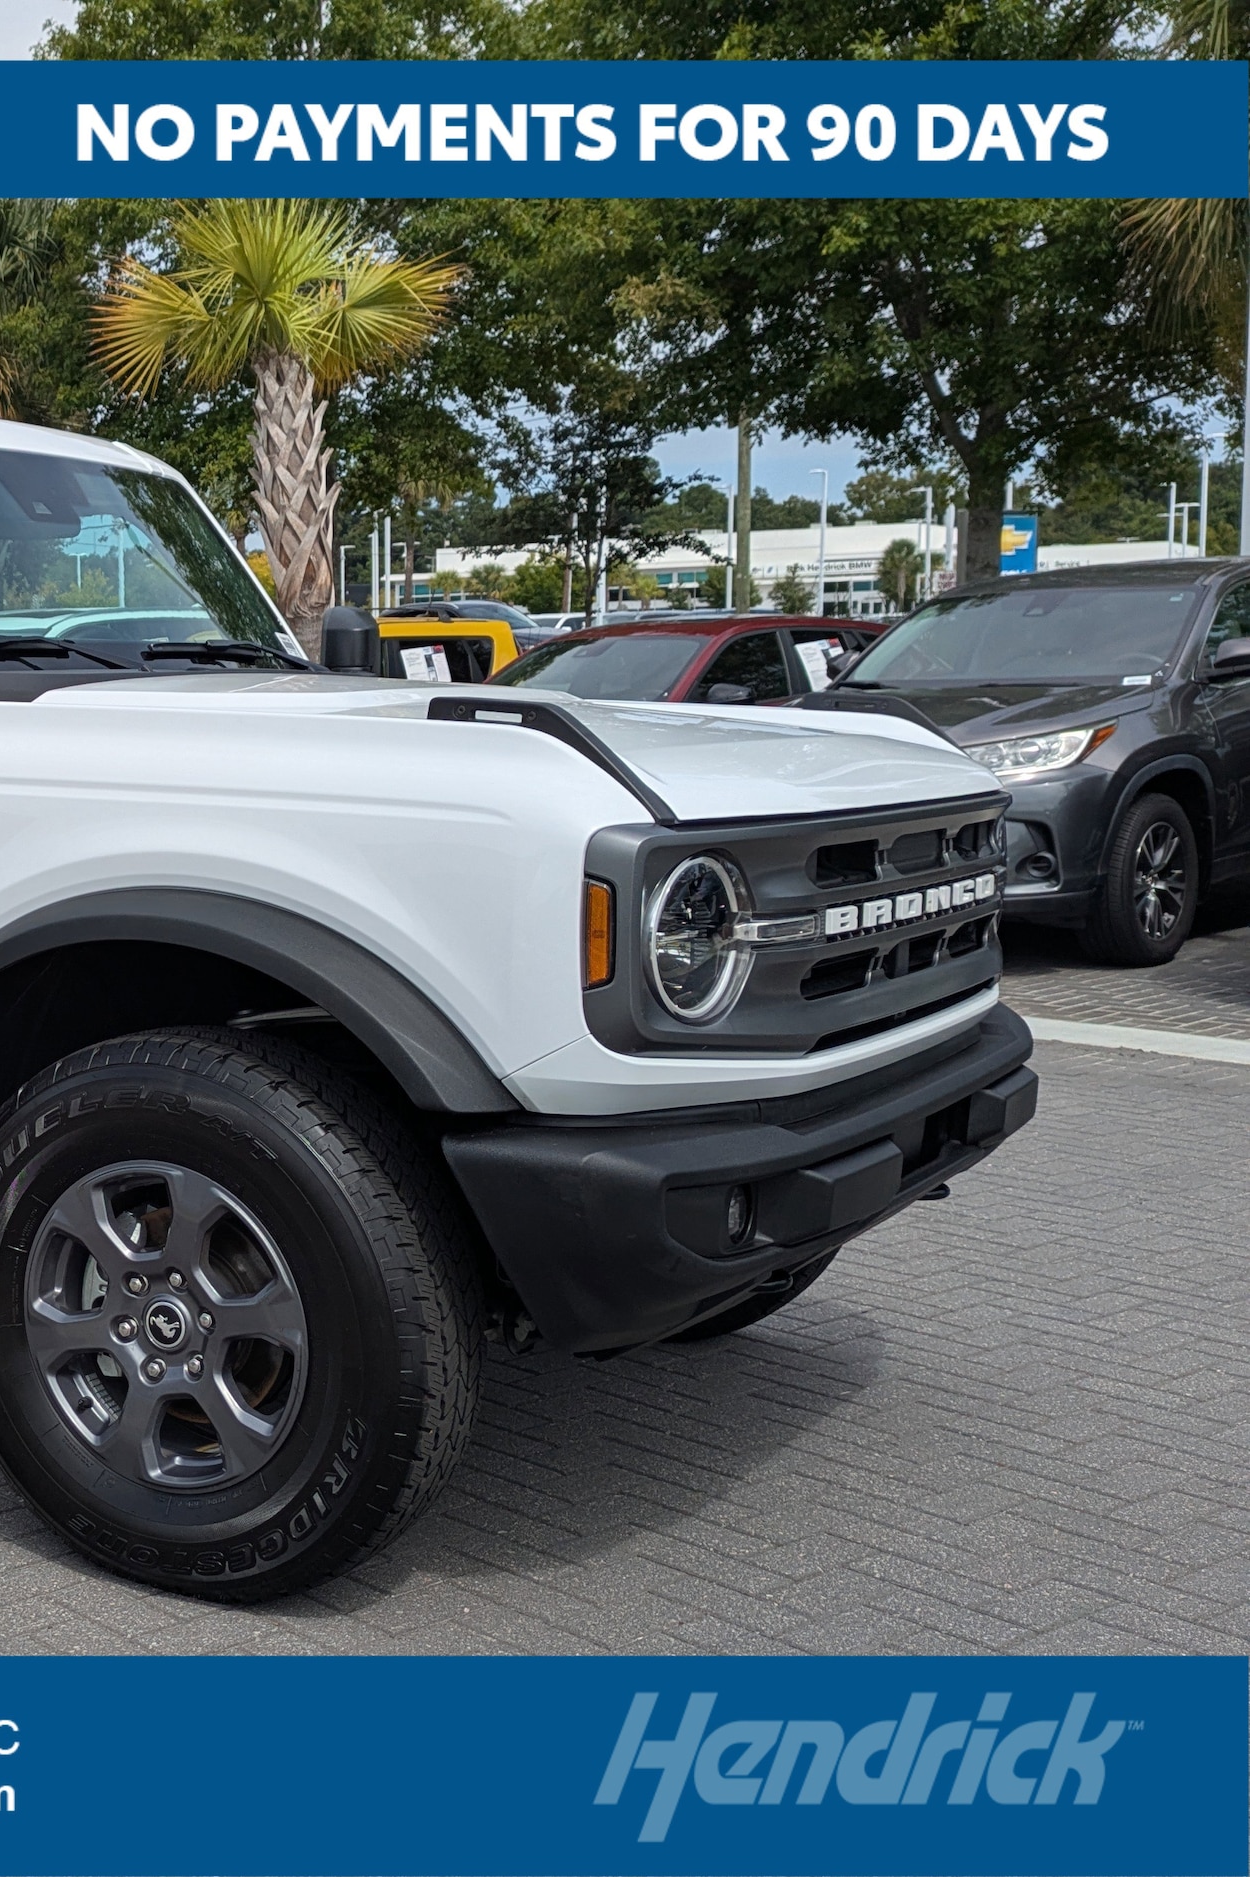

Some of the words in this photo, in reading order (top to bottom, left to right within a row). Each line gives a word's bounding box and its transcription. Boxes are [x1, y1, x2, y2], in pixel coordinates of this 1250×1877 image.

[848, 560, 873, 570] BMW
[825, 873, 995, 935] BRONCO
[68, 1408, 368, 1577] BRIDGESTONE
